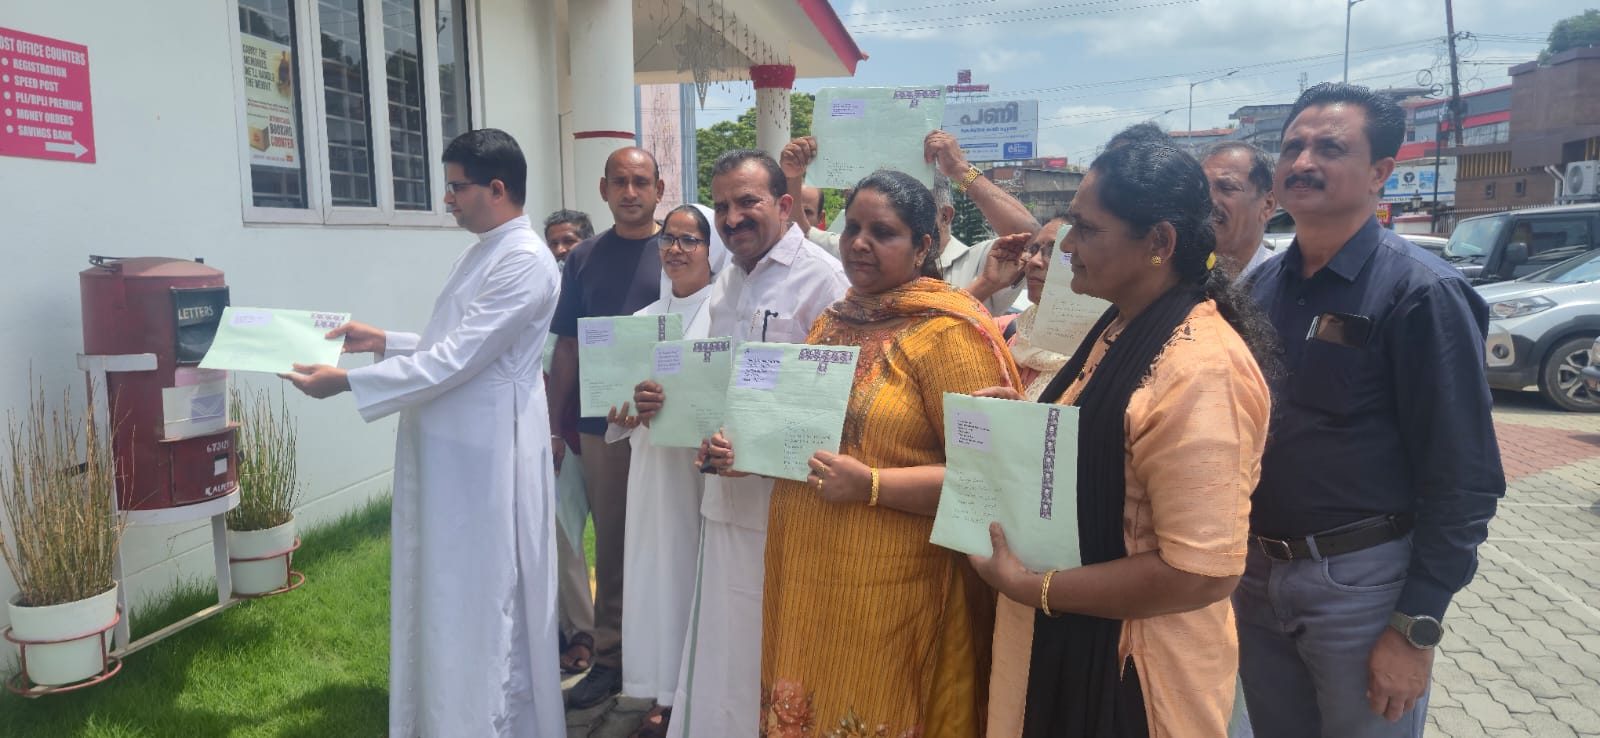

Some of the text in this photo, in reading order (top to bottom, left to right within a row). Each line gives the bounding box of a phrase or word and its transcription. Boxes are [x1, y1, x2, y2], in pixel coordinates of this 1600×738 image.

[16, 40, 44, 58] OFFICE
[45, 46, 86, 66] COUNTERS
[258, 48, 267, 59] THE
[13, 58, 67, 78] REGISTRATION
[14, 75, 59, 93] SPEED POST
[245, 77, 254, 88] THE
[15, 92, 84, 112] PLI/RPLI PREMIUM
[16, 108, 75, 126] MONEY ORDERS
[960, 101, 1019, 125] പണി
[18, 125, 73, 140] SAVINGS BANK
[269, 123, 293, 137] BOOKING
[270, 136, 295, 149] COUNTER
[178, 305, 214, 320] LETTERS
